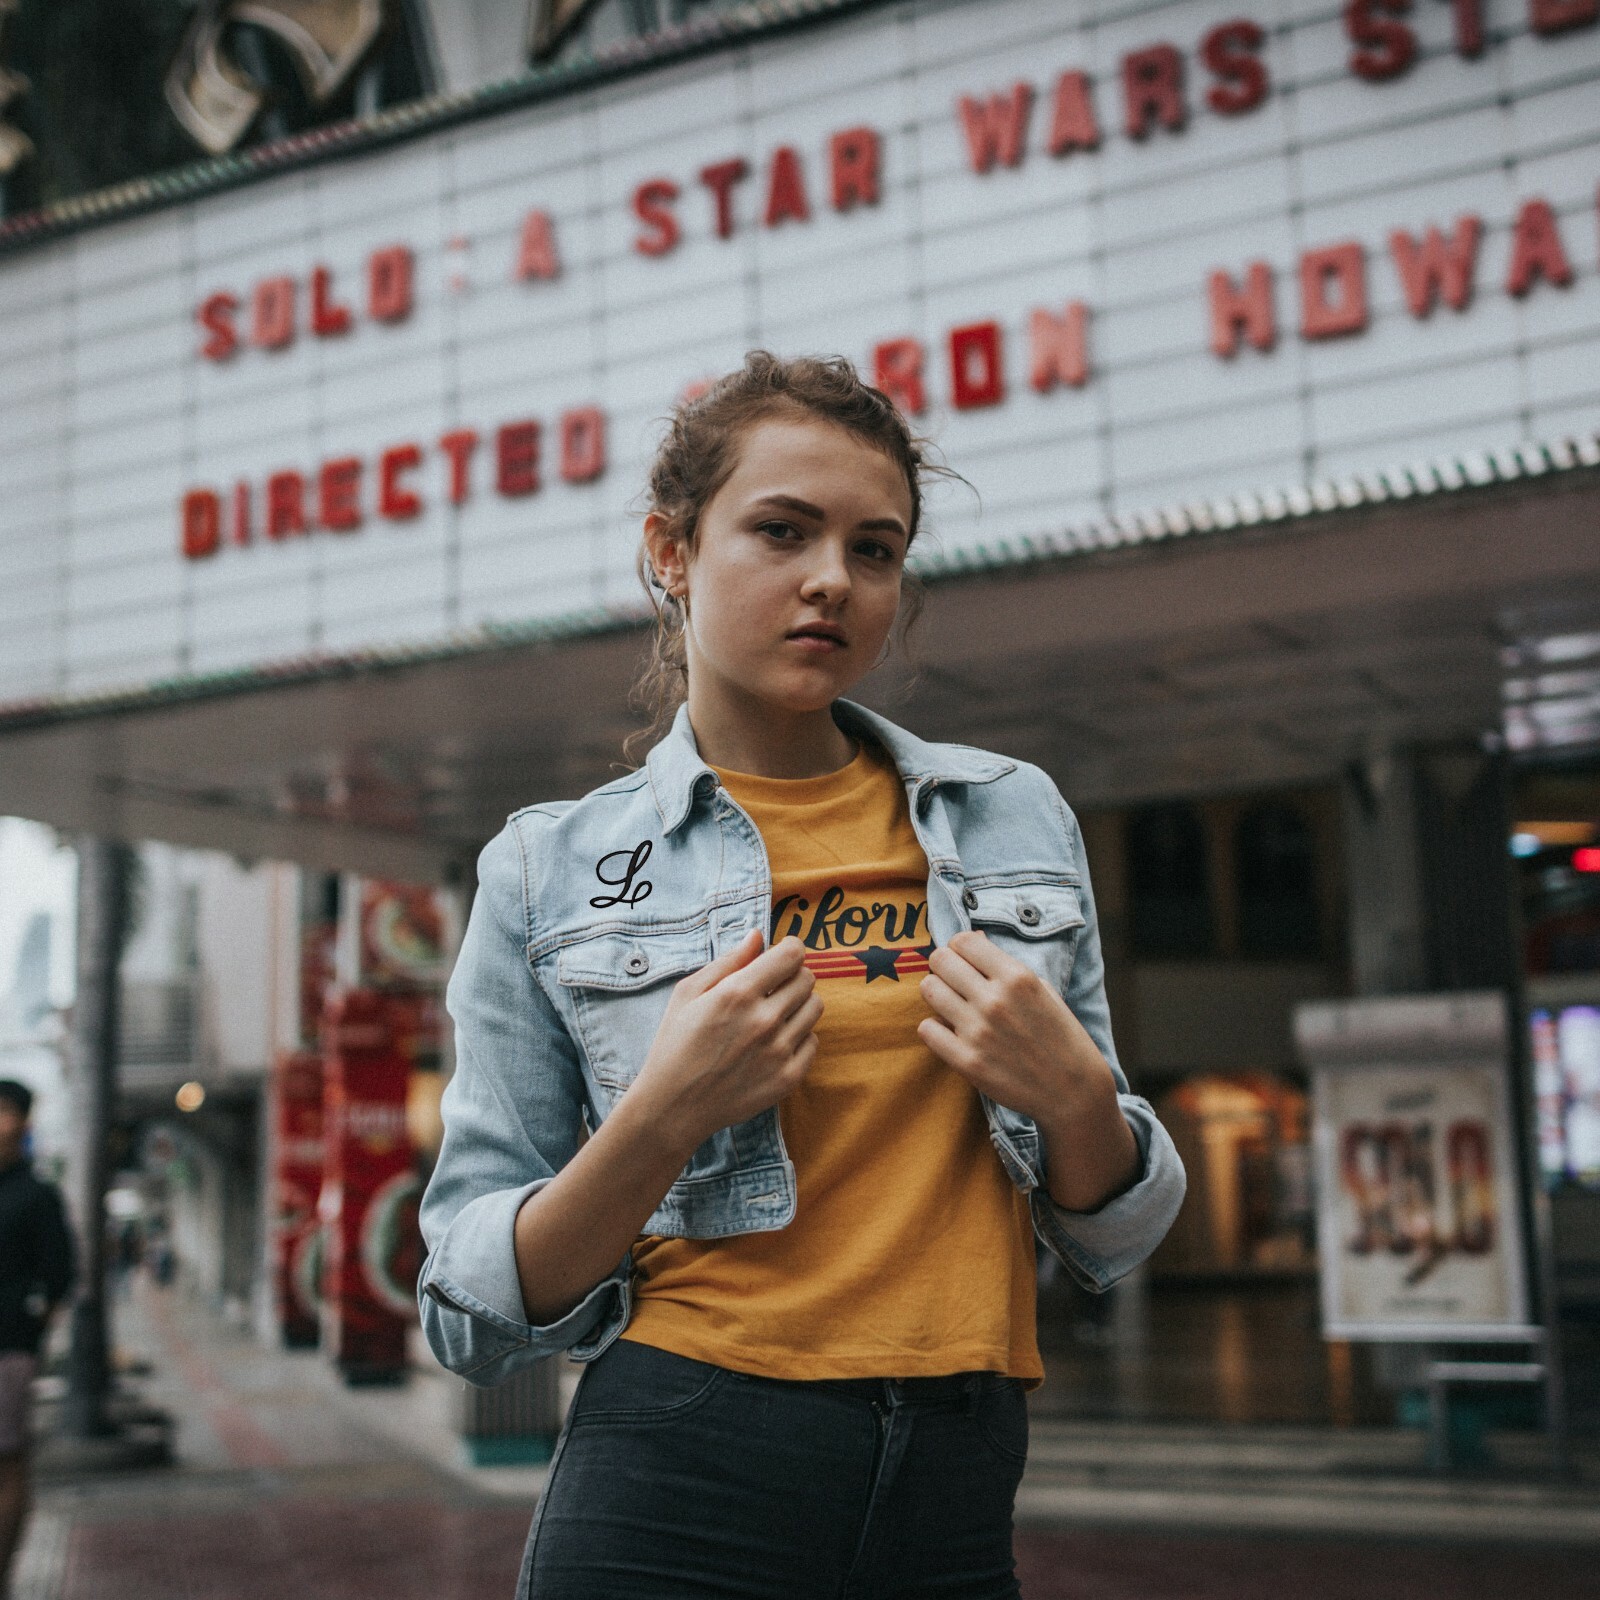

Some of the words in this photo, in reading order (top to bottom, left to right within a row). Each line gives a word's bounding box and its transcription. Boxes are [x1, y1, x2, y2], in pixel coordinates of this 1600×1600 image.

[516, 209, 562, 282] A
[630, 126, 882, 257] STAR
[958, 19, 1270, 175] WARS
[180, 403, 609, 558] DIRECTED
[873, 301, 1092, 415] RON
[1207, 176, 1600, 360] HOWA
